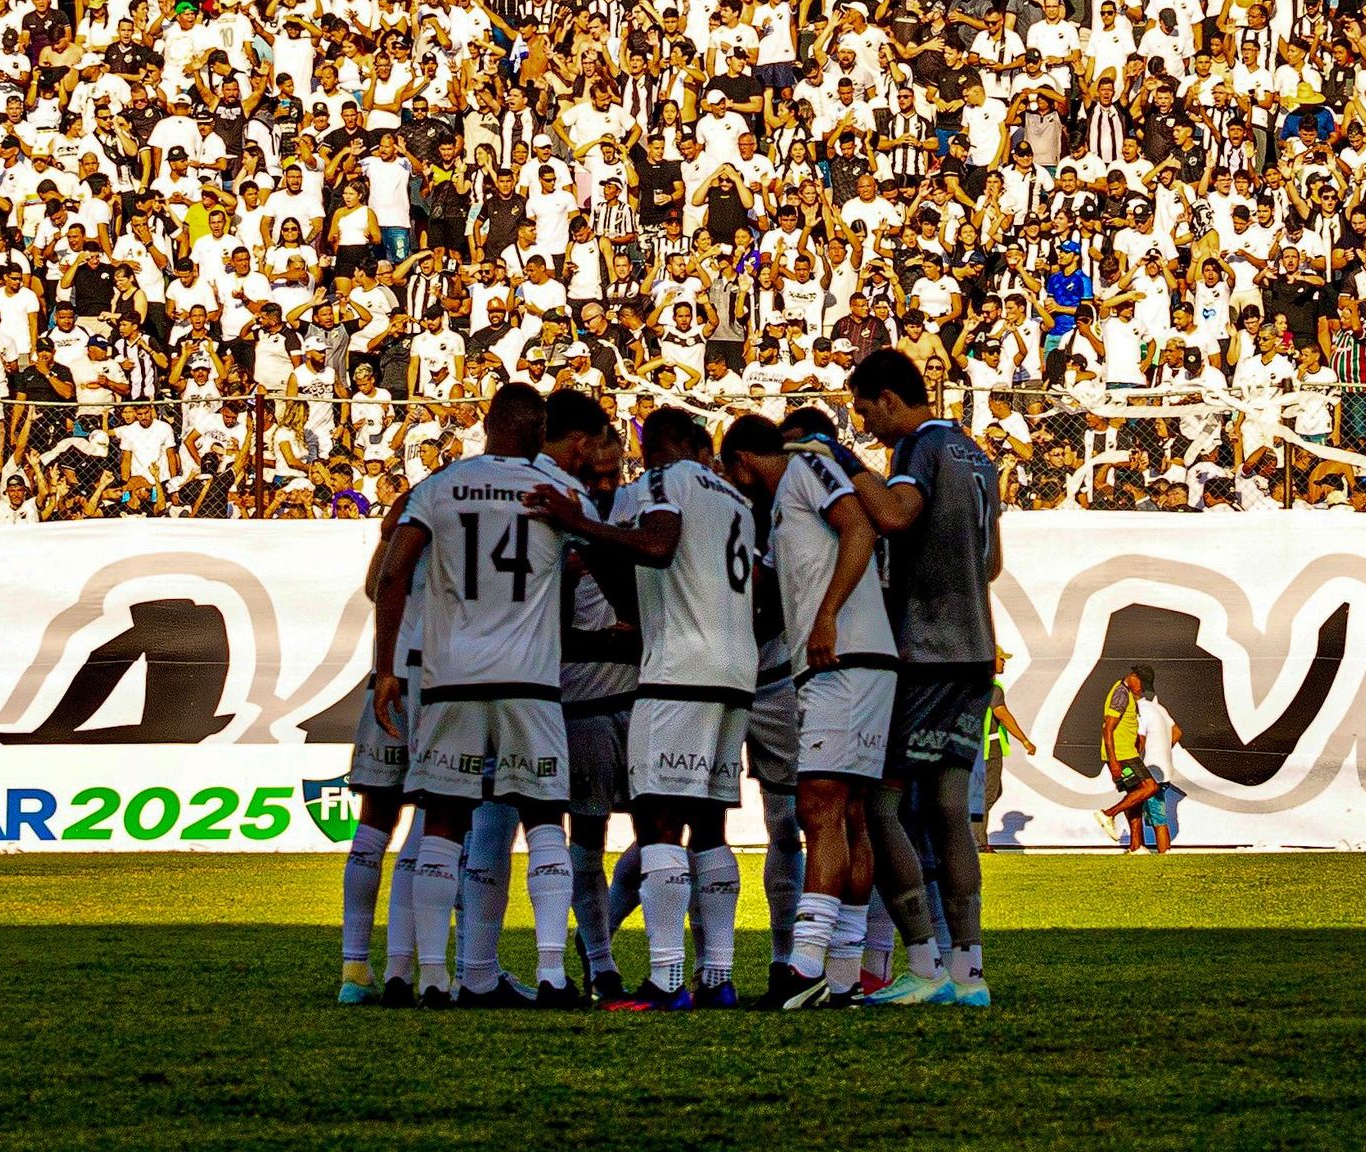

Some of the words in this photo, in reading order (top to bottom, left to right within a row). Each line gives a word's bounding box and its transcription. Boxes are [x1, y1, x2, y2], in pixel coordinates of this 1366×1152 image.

[219, 28, 234, 48] 10
[452, 484, 525, 502] Unime
[459, 512, 533, 602] 14
[726, 524, 747, 596] 6
[61, 786, 294, 841] 2025
